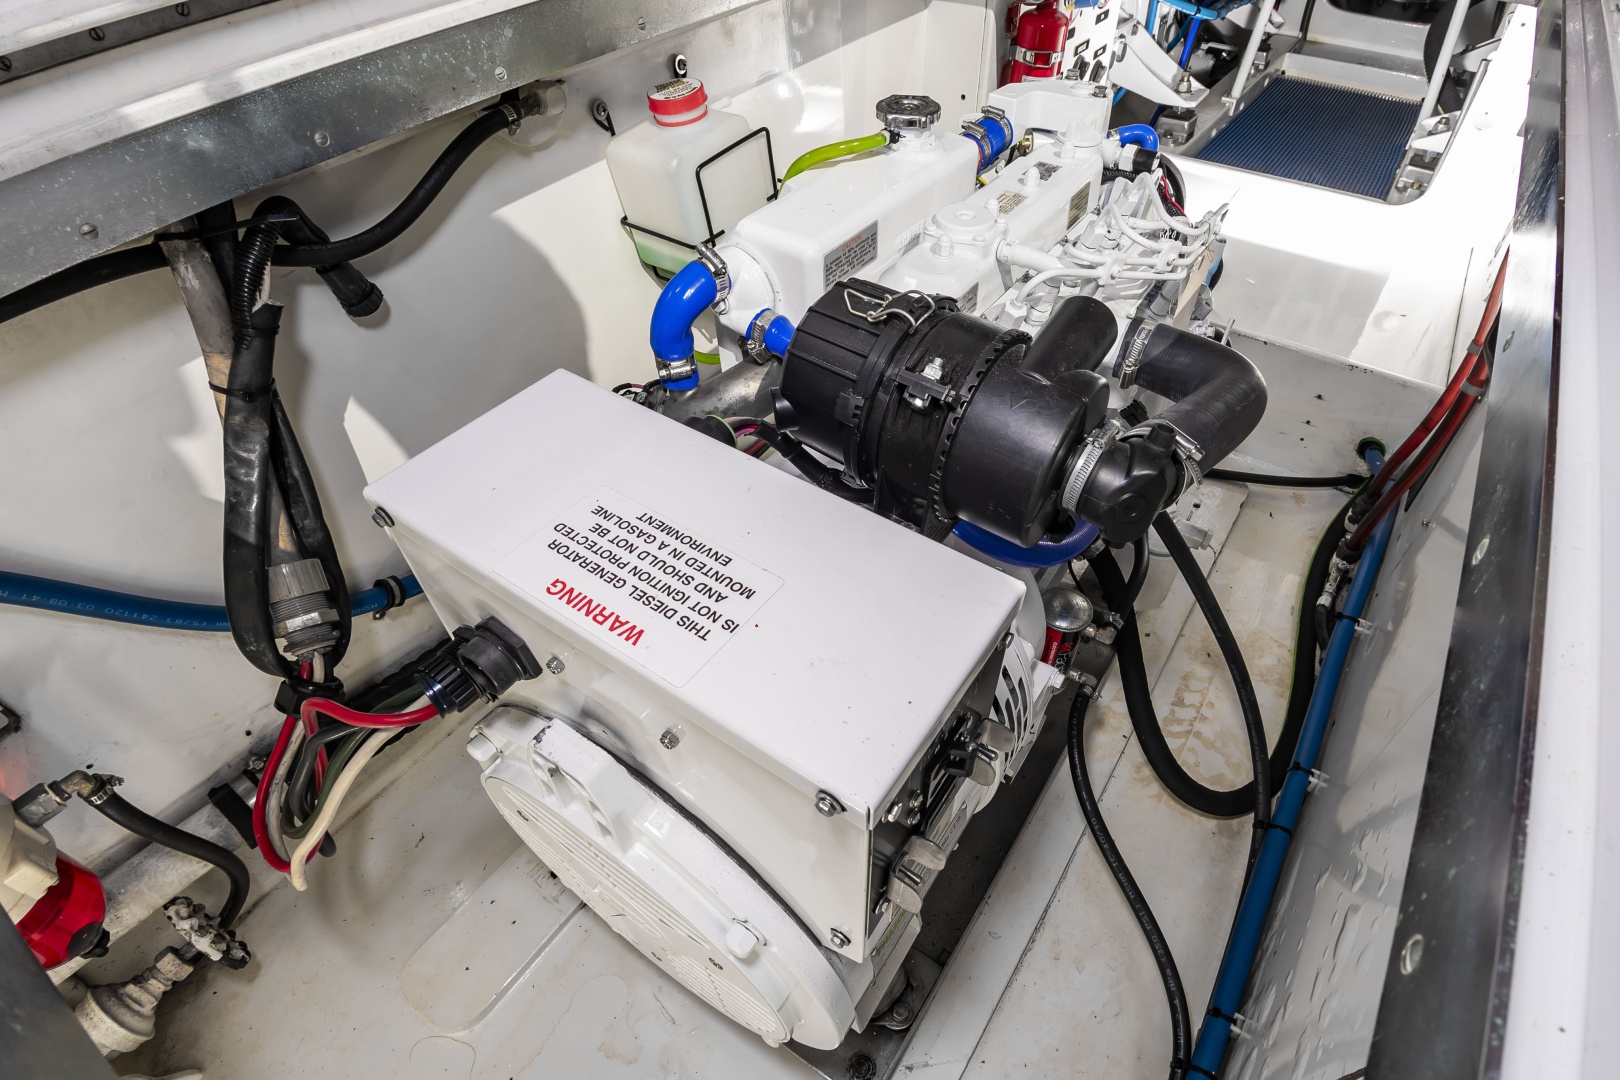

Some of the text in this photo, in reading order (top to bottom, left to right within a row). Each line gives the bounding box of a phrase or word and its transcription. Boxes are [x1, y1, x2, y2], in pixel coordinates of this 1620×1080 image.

[841, 233, 862, 252] CAUTION
[589, 523, 728, 603] AND SHOULD NOT BE
[591, 506, 756, 599] MOUNTED IN A GASOLINE
[636, 513, 733, 566] ENVIRONMENT
[548, 539, 711, 641] THIS DIESEL GENERATOR
[554, 523, 739, 633] IS NOT IGNITION PROTECTED
[546, 579, 644, 646] WARNING
[1118, 872, 1136, 899] MSHA
[1135, 903, 1152, 930] PSI)
[1151, 935, 1166, 962] (350
